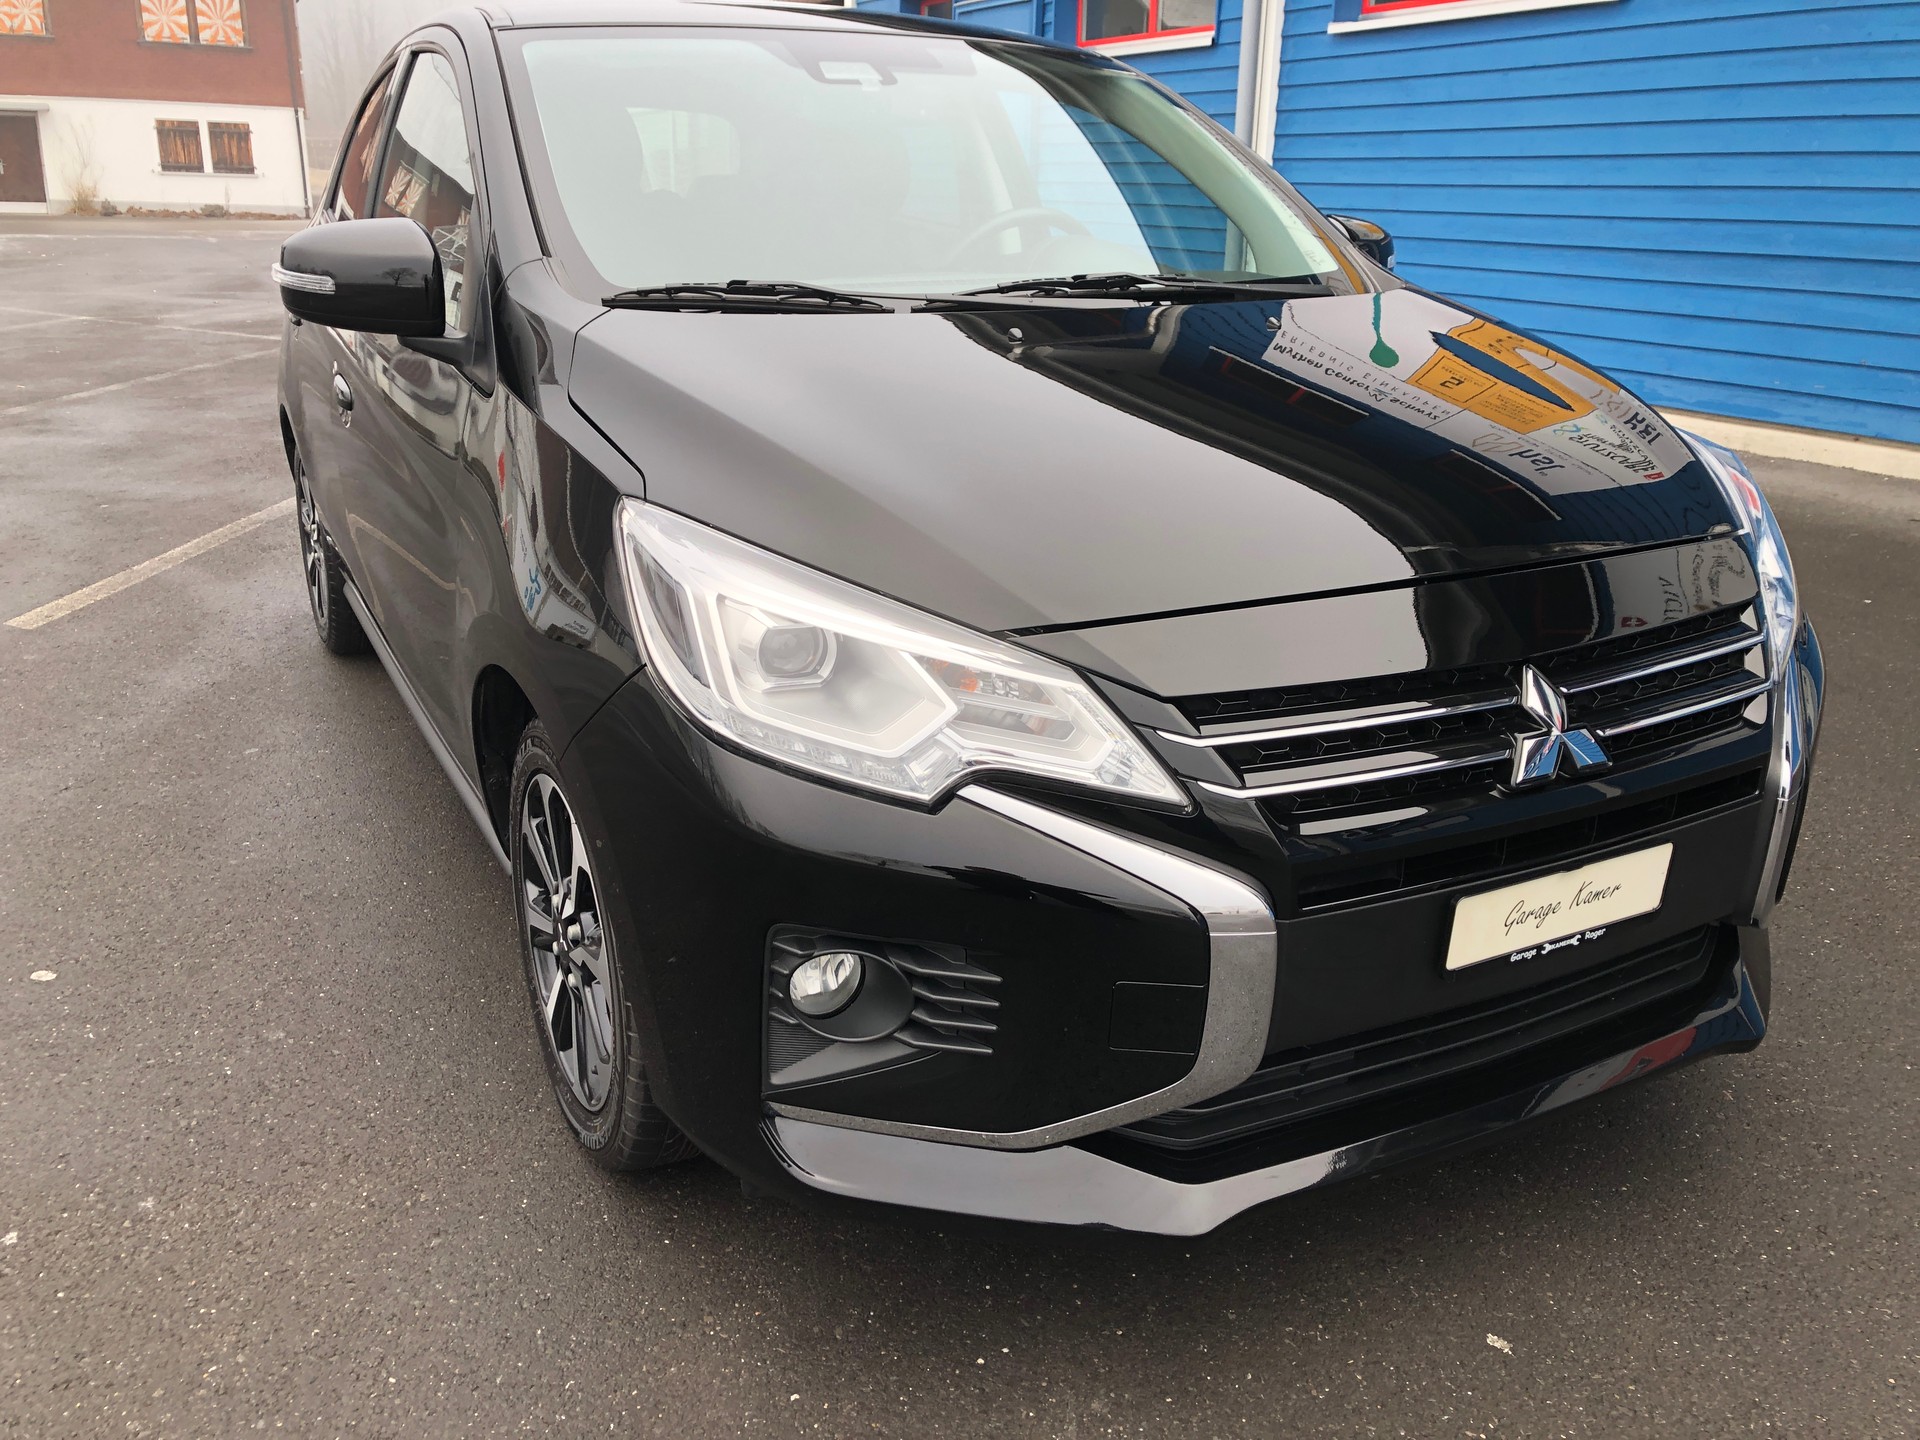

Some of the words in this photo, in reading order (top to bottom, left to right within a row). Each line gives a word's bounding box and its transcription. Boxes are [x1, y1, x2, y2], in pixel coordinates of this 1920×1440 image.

[1504, 899, 1561, 936] Garage
[1569, 881, 1621, 910] Kamer
[1510, 948, 1537, 962] Garage
[1585, 928, 1606, 940] Roger
